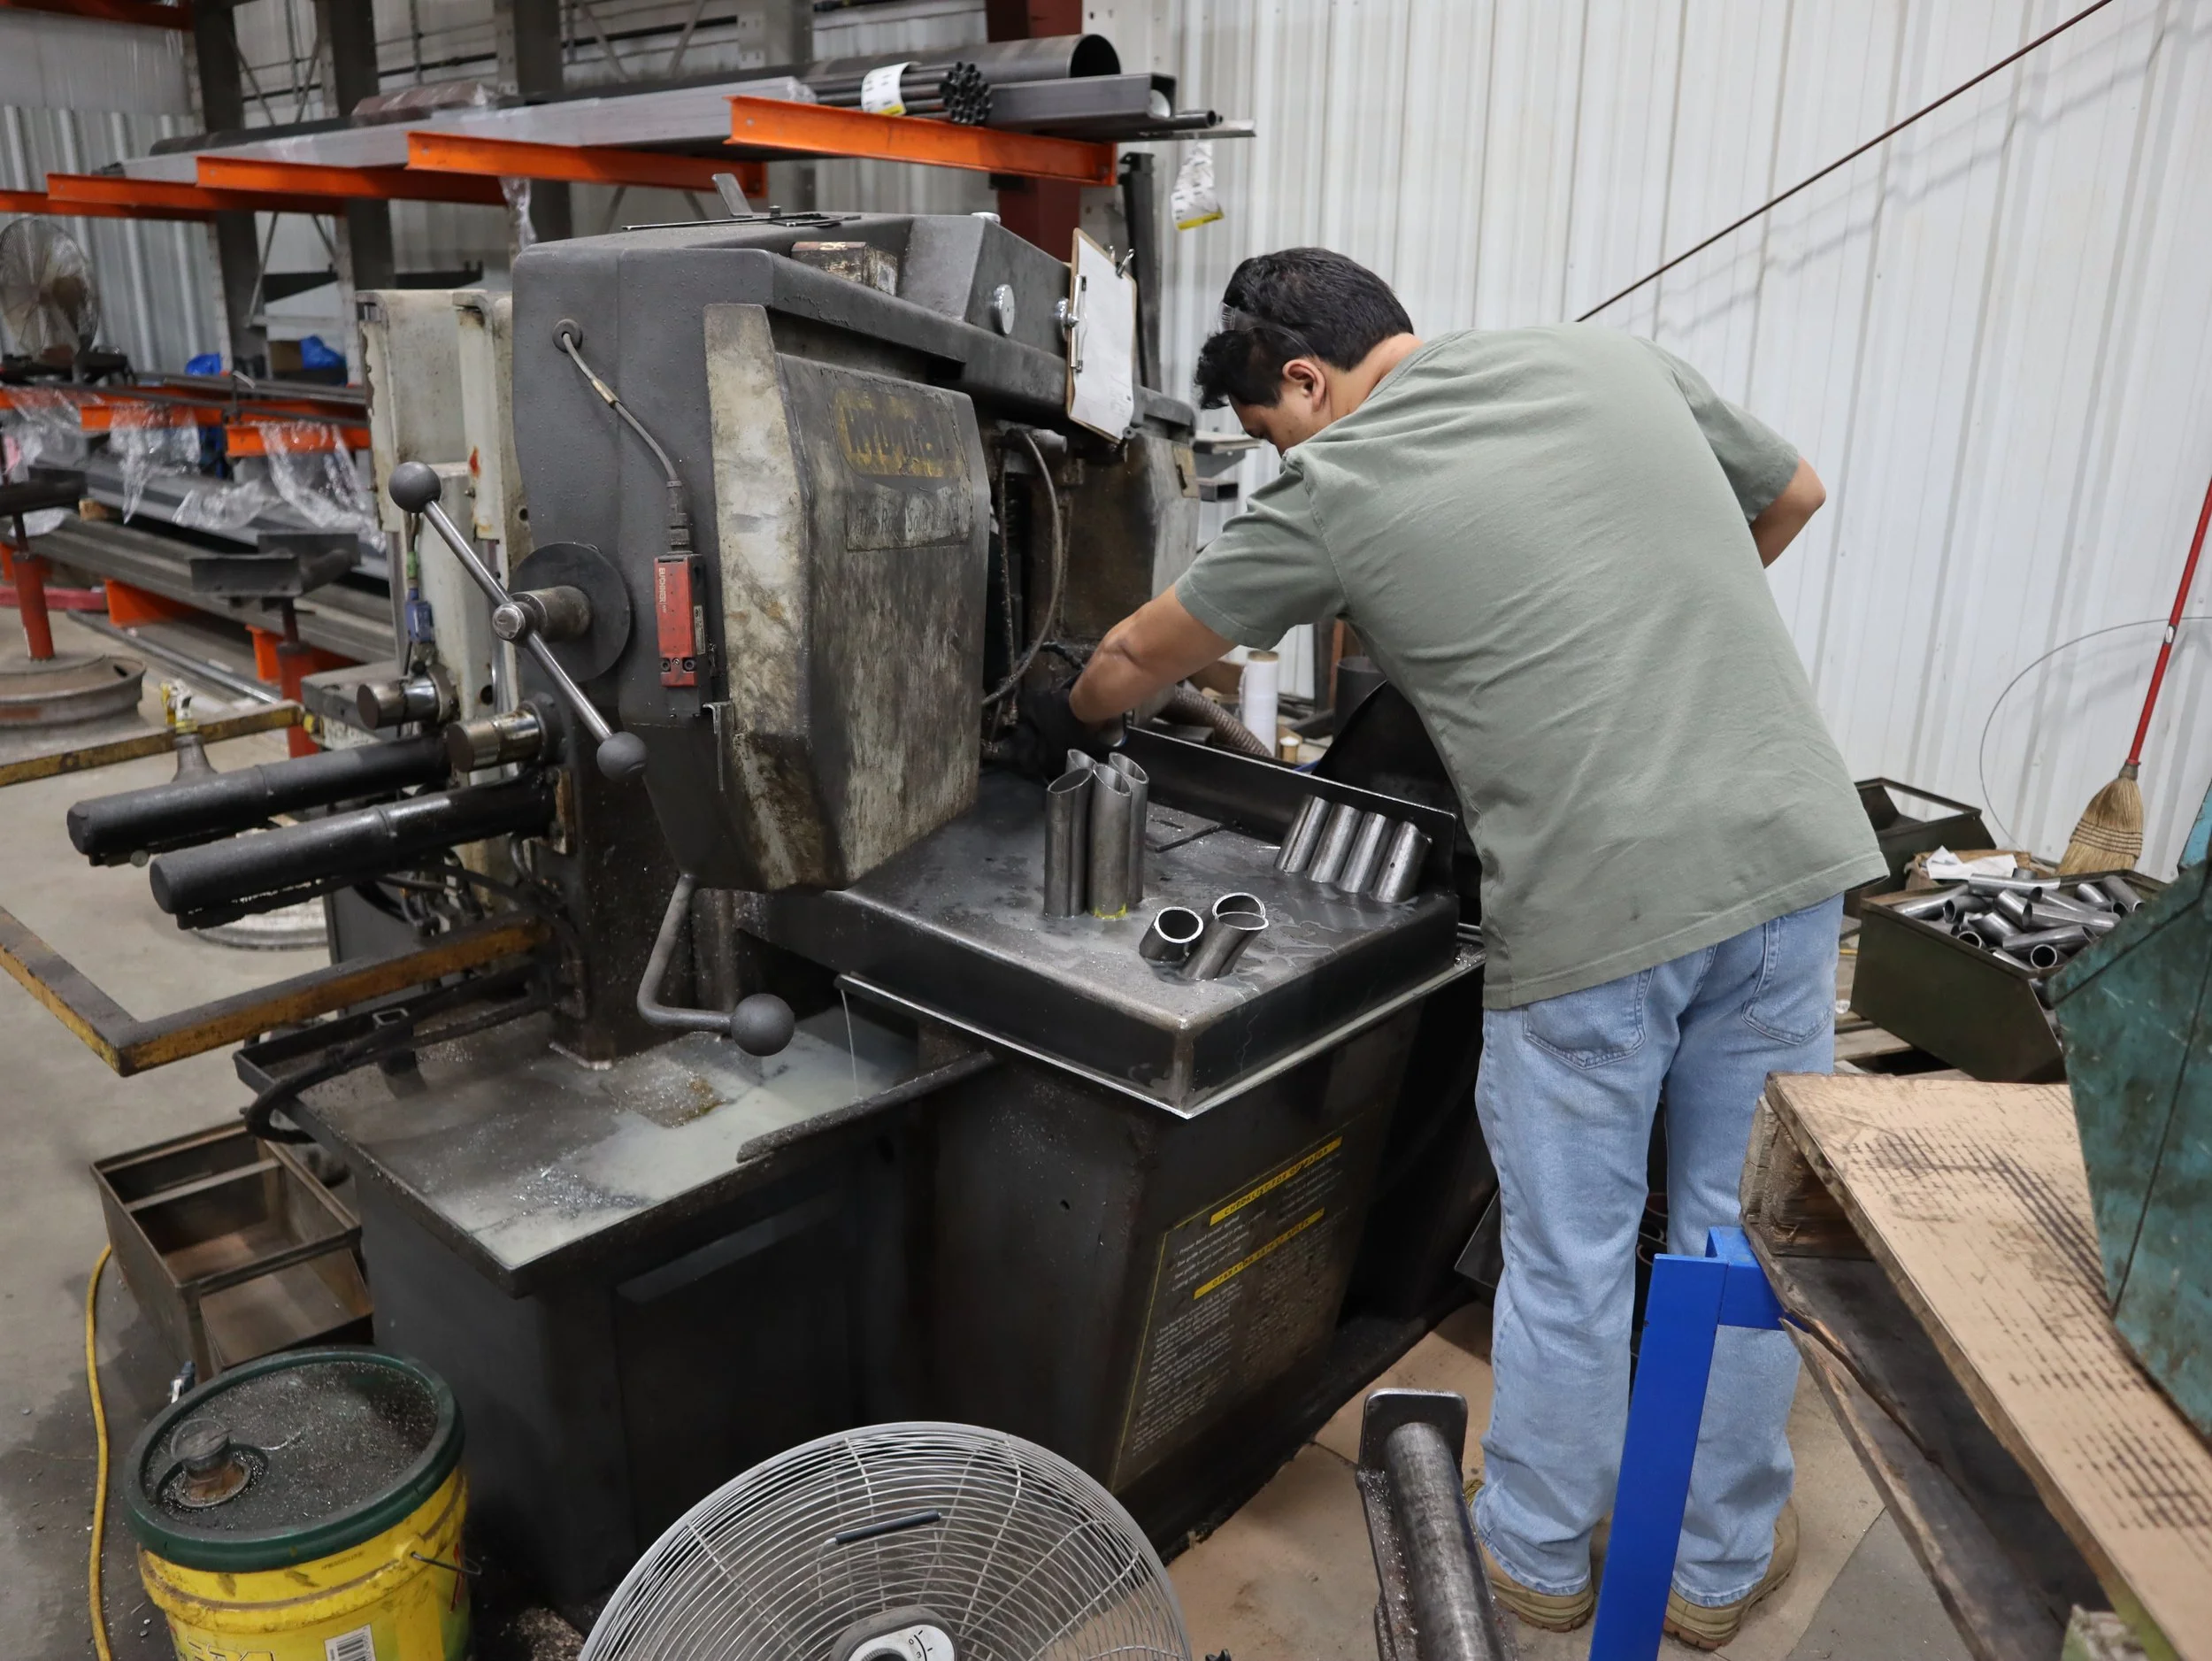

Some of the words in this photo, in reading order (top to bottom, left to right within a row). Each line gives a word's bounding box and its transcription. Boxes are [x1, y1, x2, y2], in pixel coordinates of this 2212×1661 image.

[1224, 1183, 1270, 1215] CHECKLIST
[1271, 1173, 1287, 1188] FOR
[1212, 1256, 1255, 1286] OPERATOR
